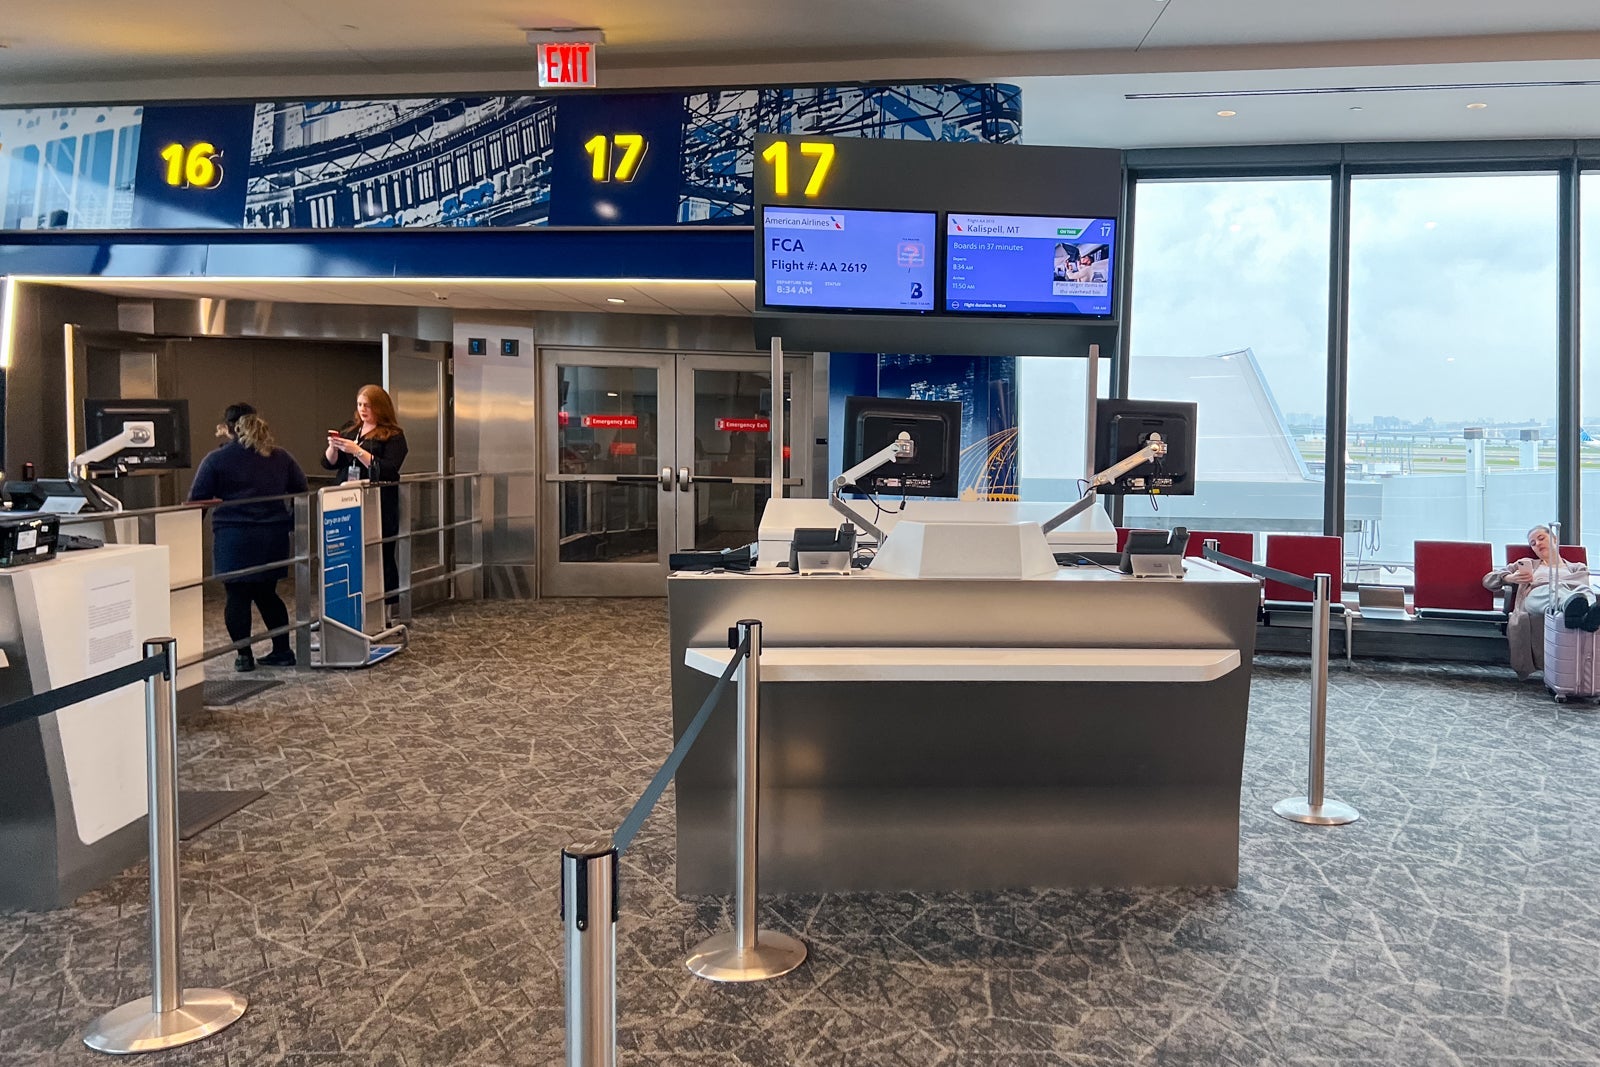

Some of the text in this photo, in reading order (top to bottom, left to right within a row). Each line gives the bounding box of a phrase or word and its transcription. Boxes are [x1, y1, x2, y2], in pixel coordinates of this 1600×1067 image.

[546, 46, 590, 83] EXIT
[584, 134, 644, 181] 17
[161, 142, 216, 187] 16
[762, 141, 836, 197] 17
[765, 217, 830, 227] American Airlines
[967, 224, 1020, 234] Kalispell, MT
[1100, 226, 1111, 237] 17
[771, 238, 805, 252] FCA
[953, 242, 977, 250] Boards
[771, 259, 868, 273] Flight #: AA 2619
[776, 285, 813, 295] 8:34 AM
[592, 417, 636, 426] Emergency Exit
[725, 421, 768, 429] Emergency Exit
